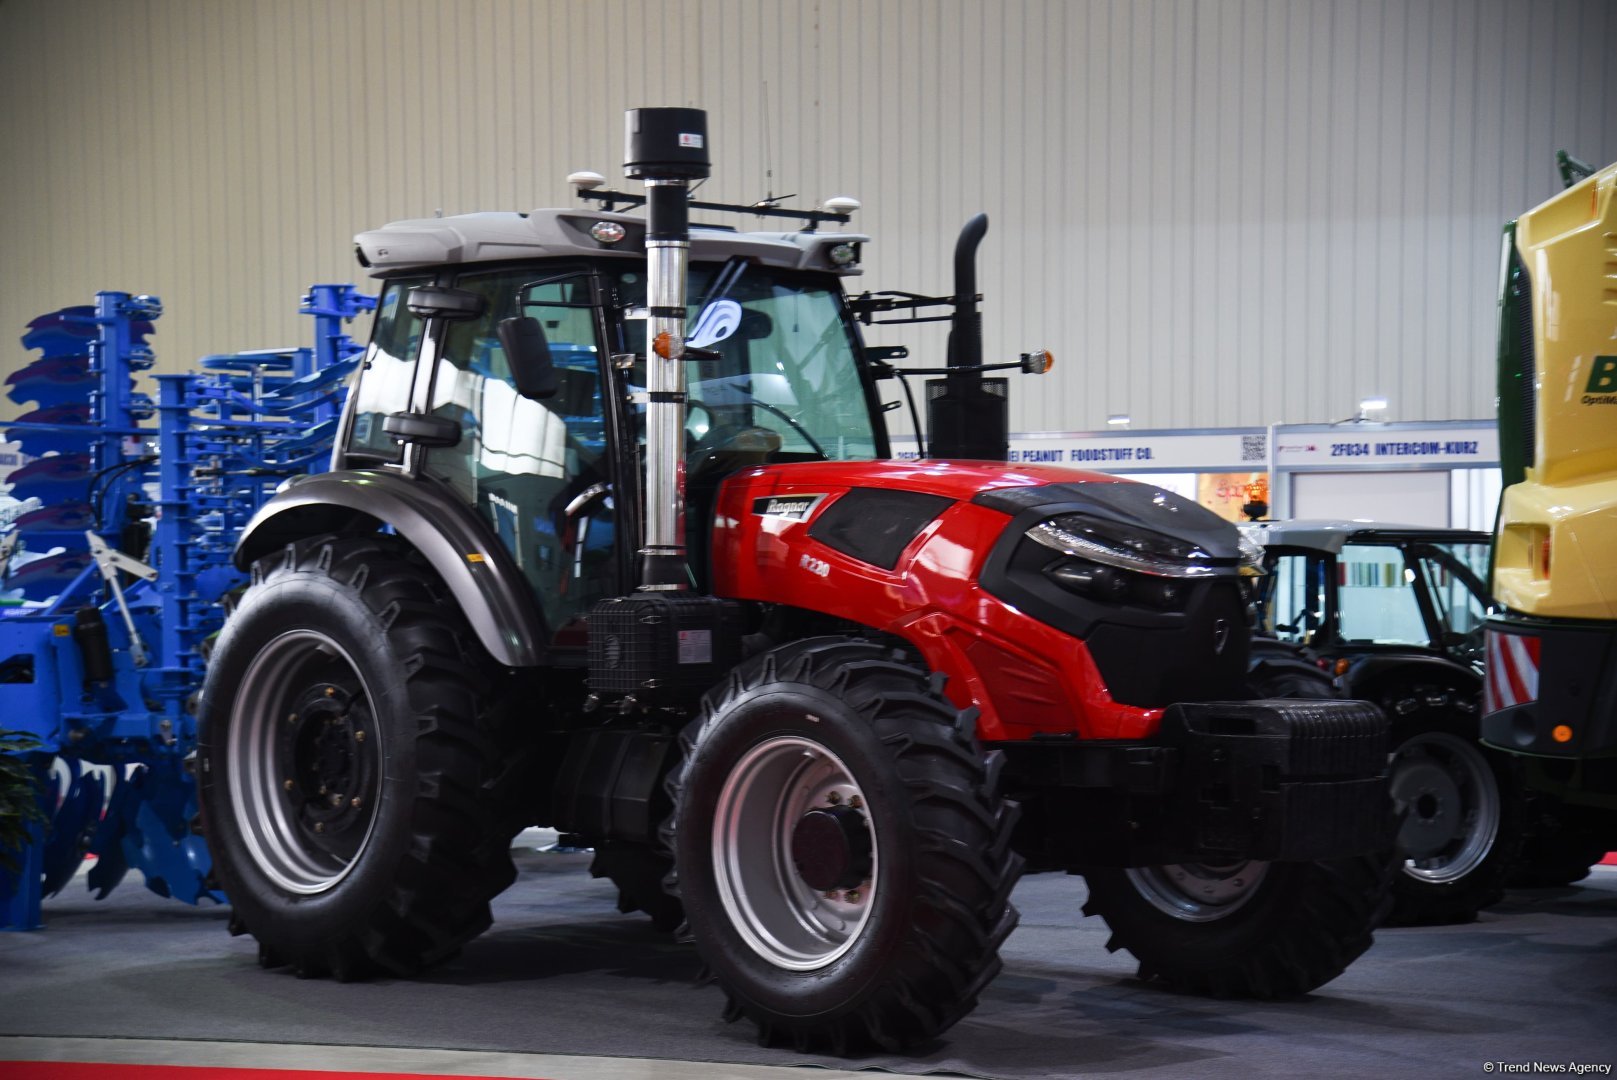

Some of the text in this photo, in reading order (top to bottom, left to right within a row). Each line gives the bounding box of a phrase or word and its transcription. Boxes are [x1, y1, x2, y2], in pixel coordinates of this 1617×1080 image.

[1022, 450, 1063, 462] PEANUT
[1071, 448, 1133, 461] FOODSTUFF
[1135, 447, 1155, 460] CO.
[1374, 441, 1479, 456] INTERCOM-KURZ
[766, 499, 810, 517] Ragnar
